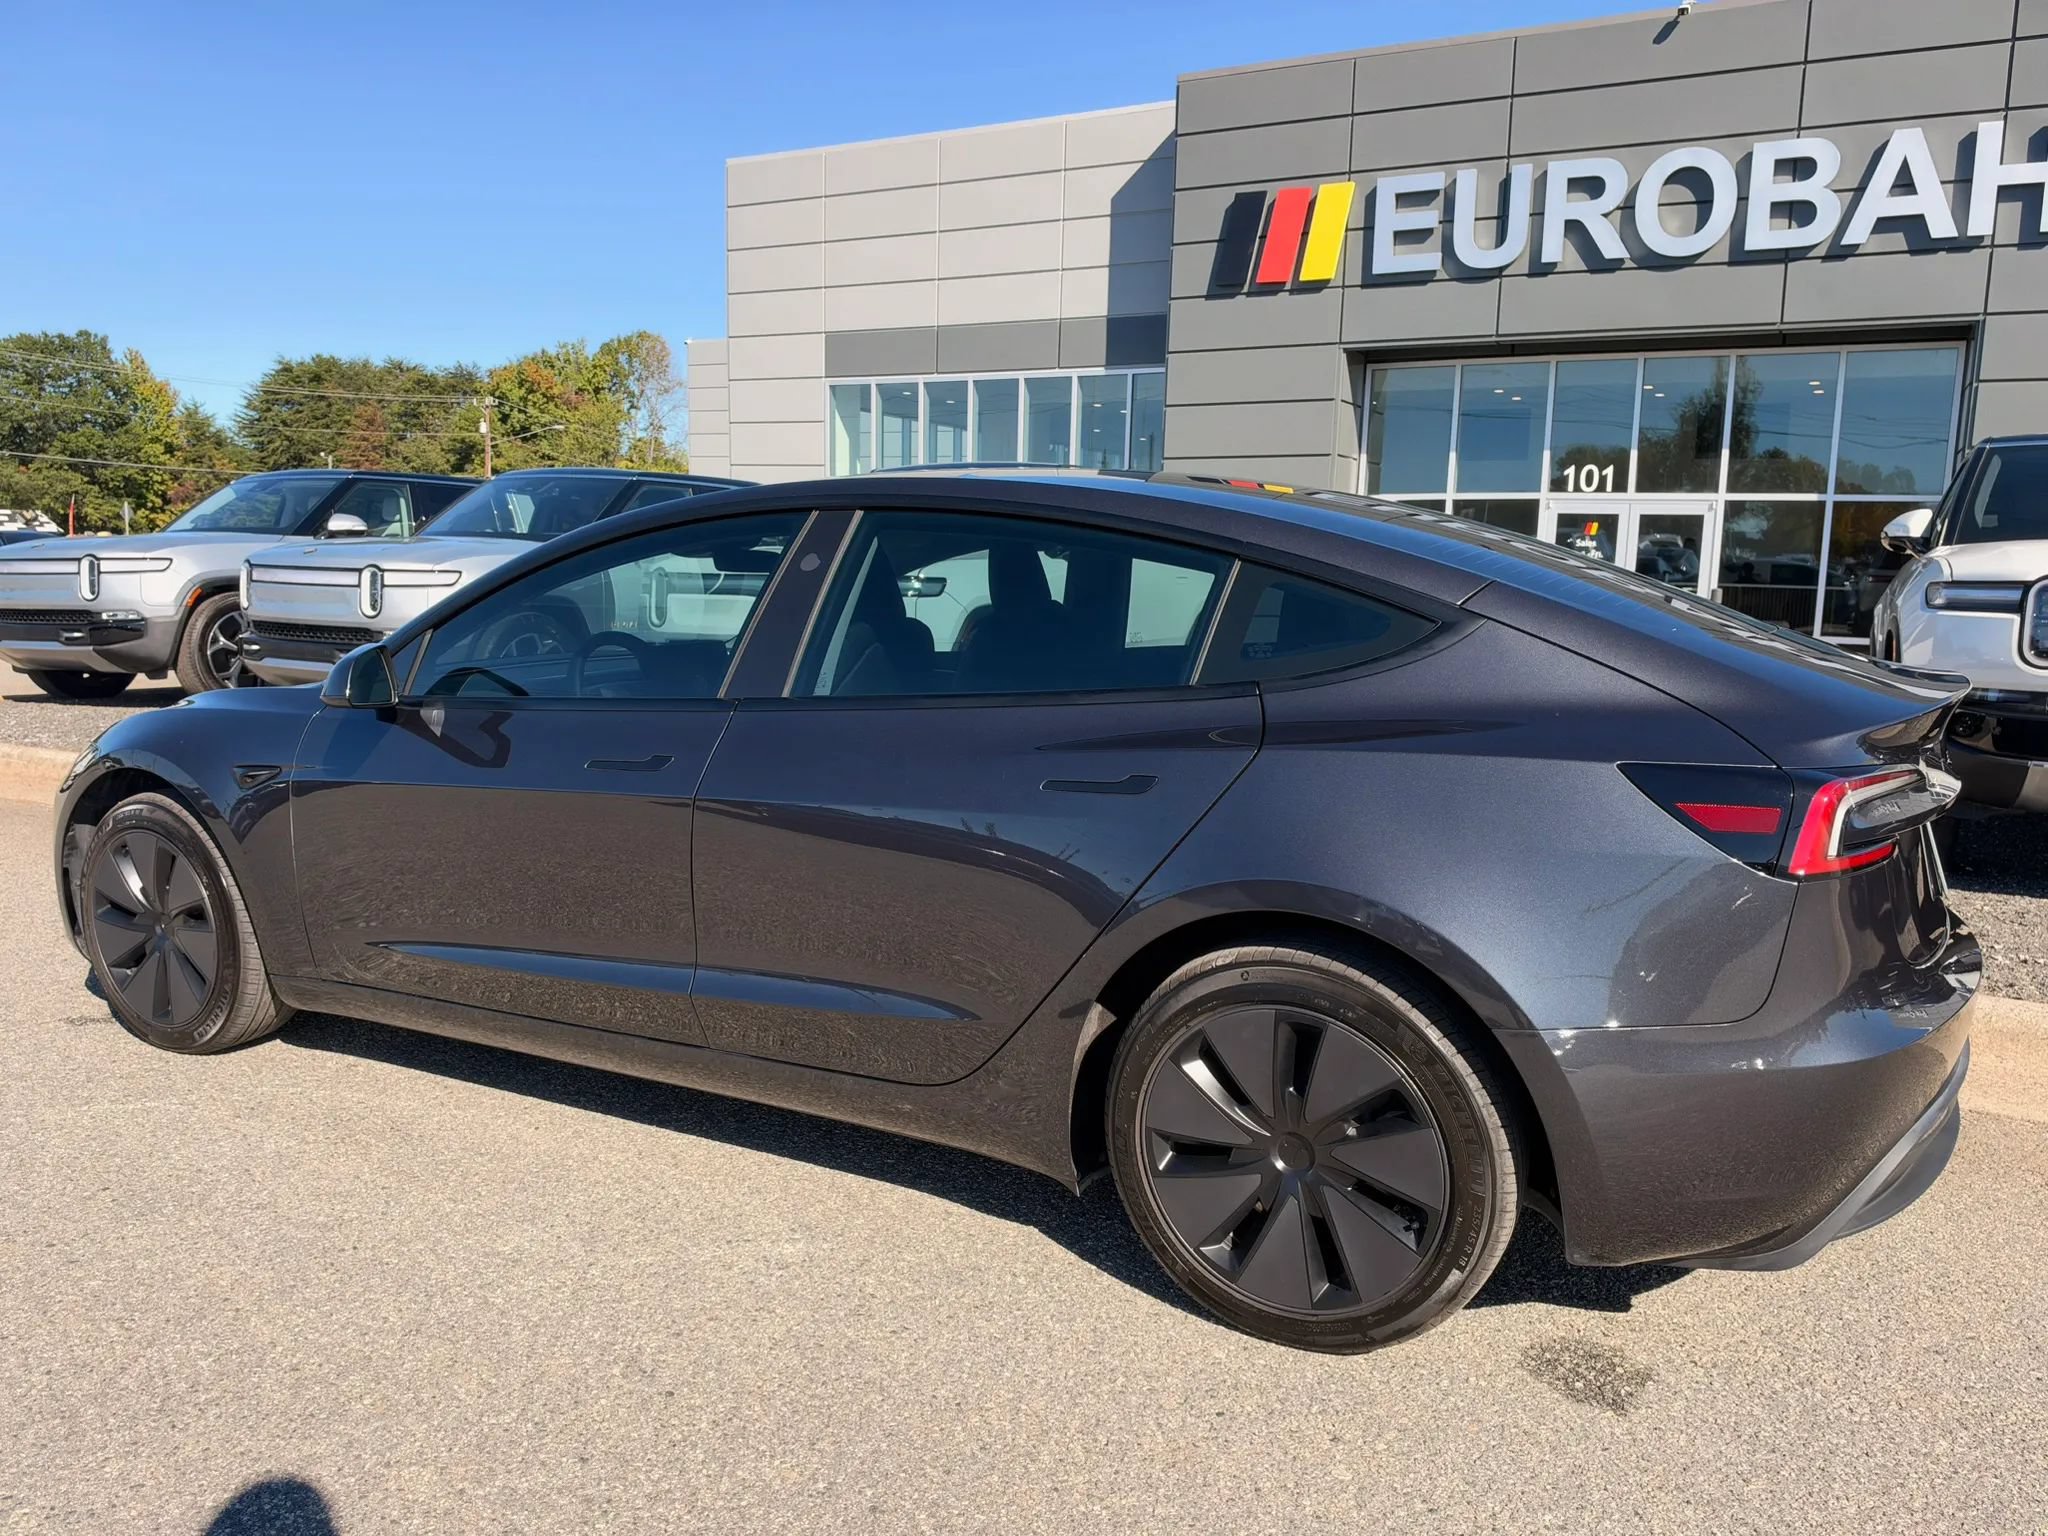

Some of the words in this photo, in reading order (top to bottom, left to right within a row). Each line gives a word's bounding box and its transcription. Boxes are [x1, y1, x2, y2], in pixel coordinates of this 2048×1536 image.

[1371, 119, 2048, 276] EUROBAH
[1563, 464, 1614, 493] 101
[1575, 538, 1598, 547] Sales
[1467, 1205, 1482, 1244] 235/45
[1463, 1246, 1473, 1254] R
[1458, 1255, 1468, 1267] 18
